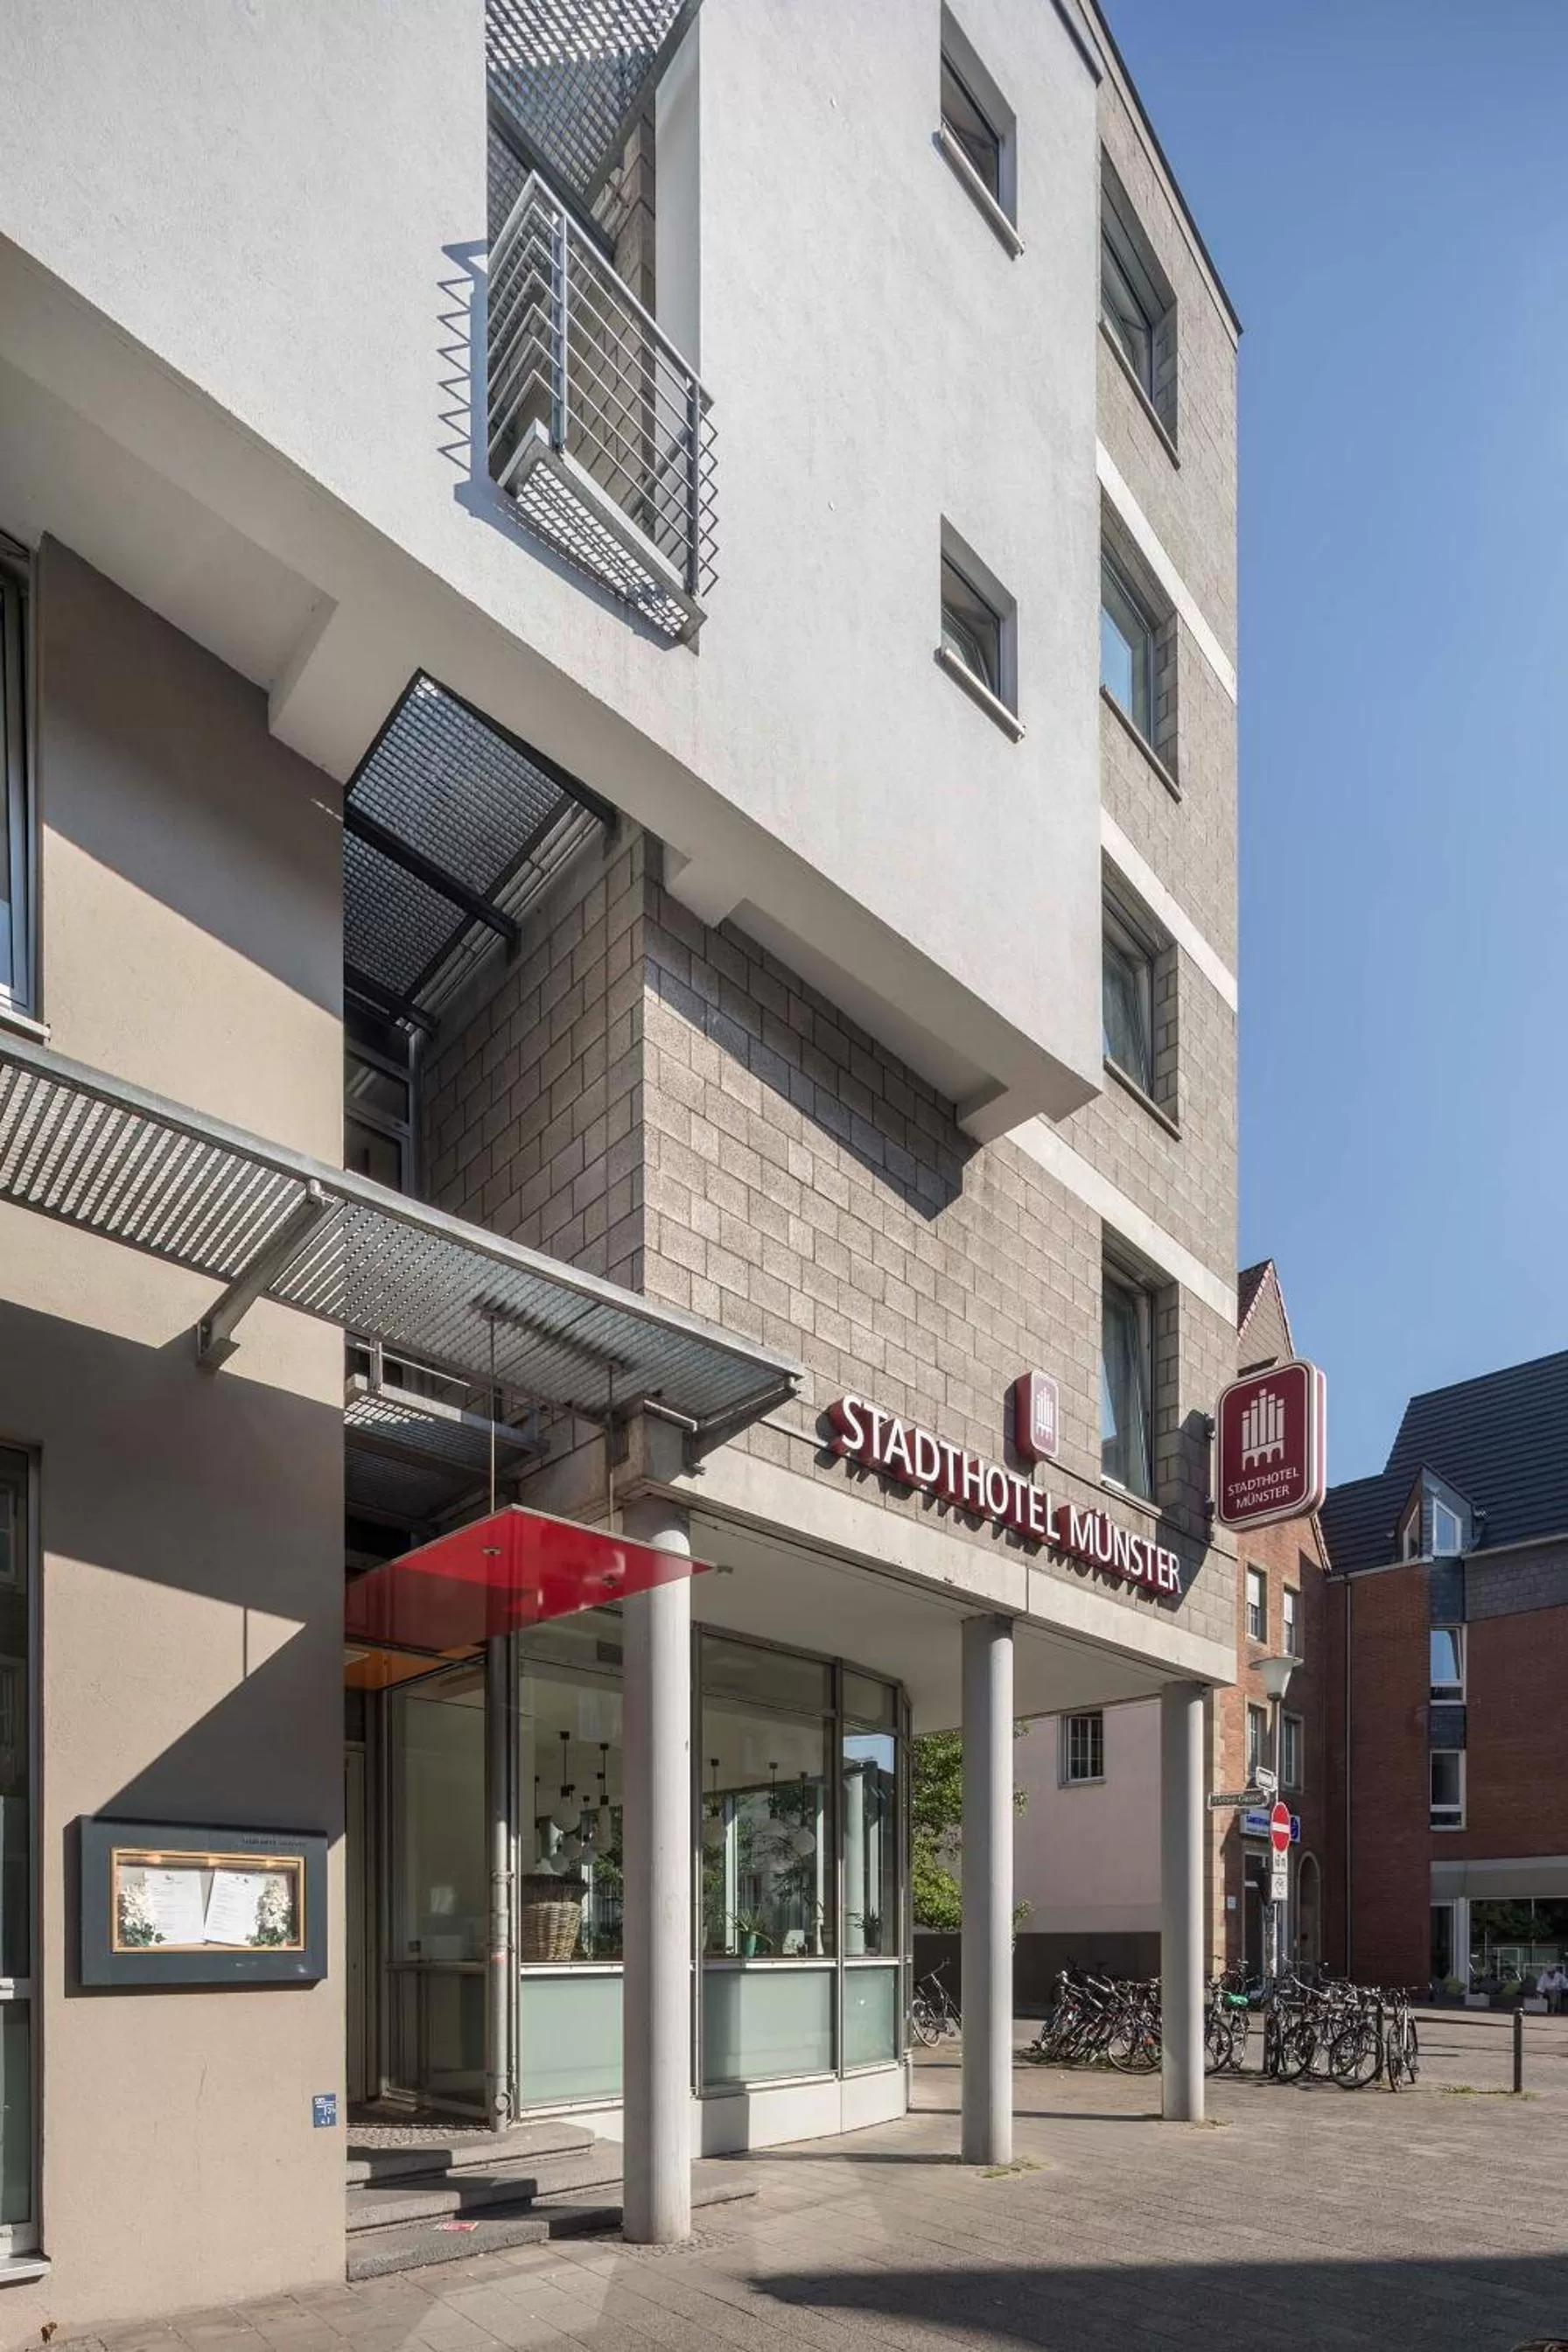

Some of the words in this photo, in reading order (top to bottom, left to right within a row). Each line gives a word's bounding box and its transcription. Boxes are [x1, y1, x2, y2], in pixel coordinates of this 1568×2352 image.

[840, 1394, 1060, 1542] STADTHOTEL
[1069, 1504, 1182, 1594] MÜNSTER
[1228, 1466, 1301, 1497] STADTHOTEL
[1236, 1484, 1290, 1509] MÜNSTER
